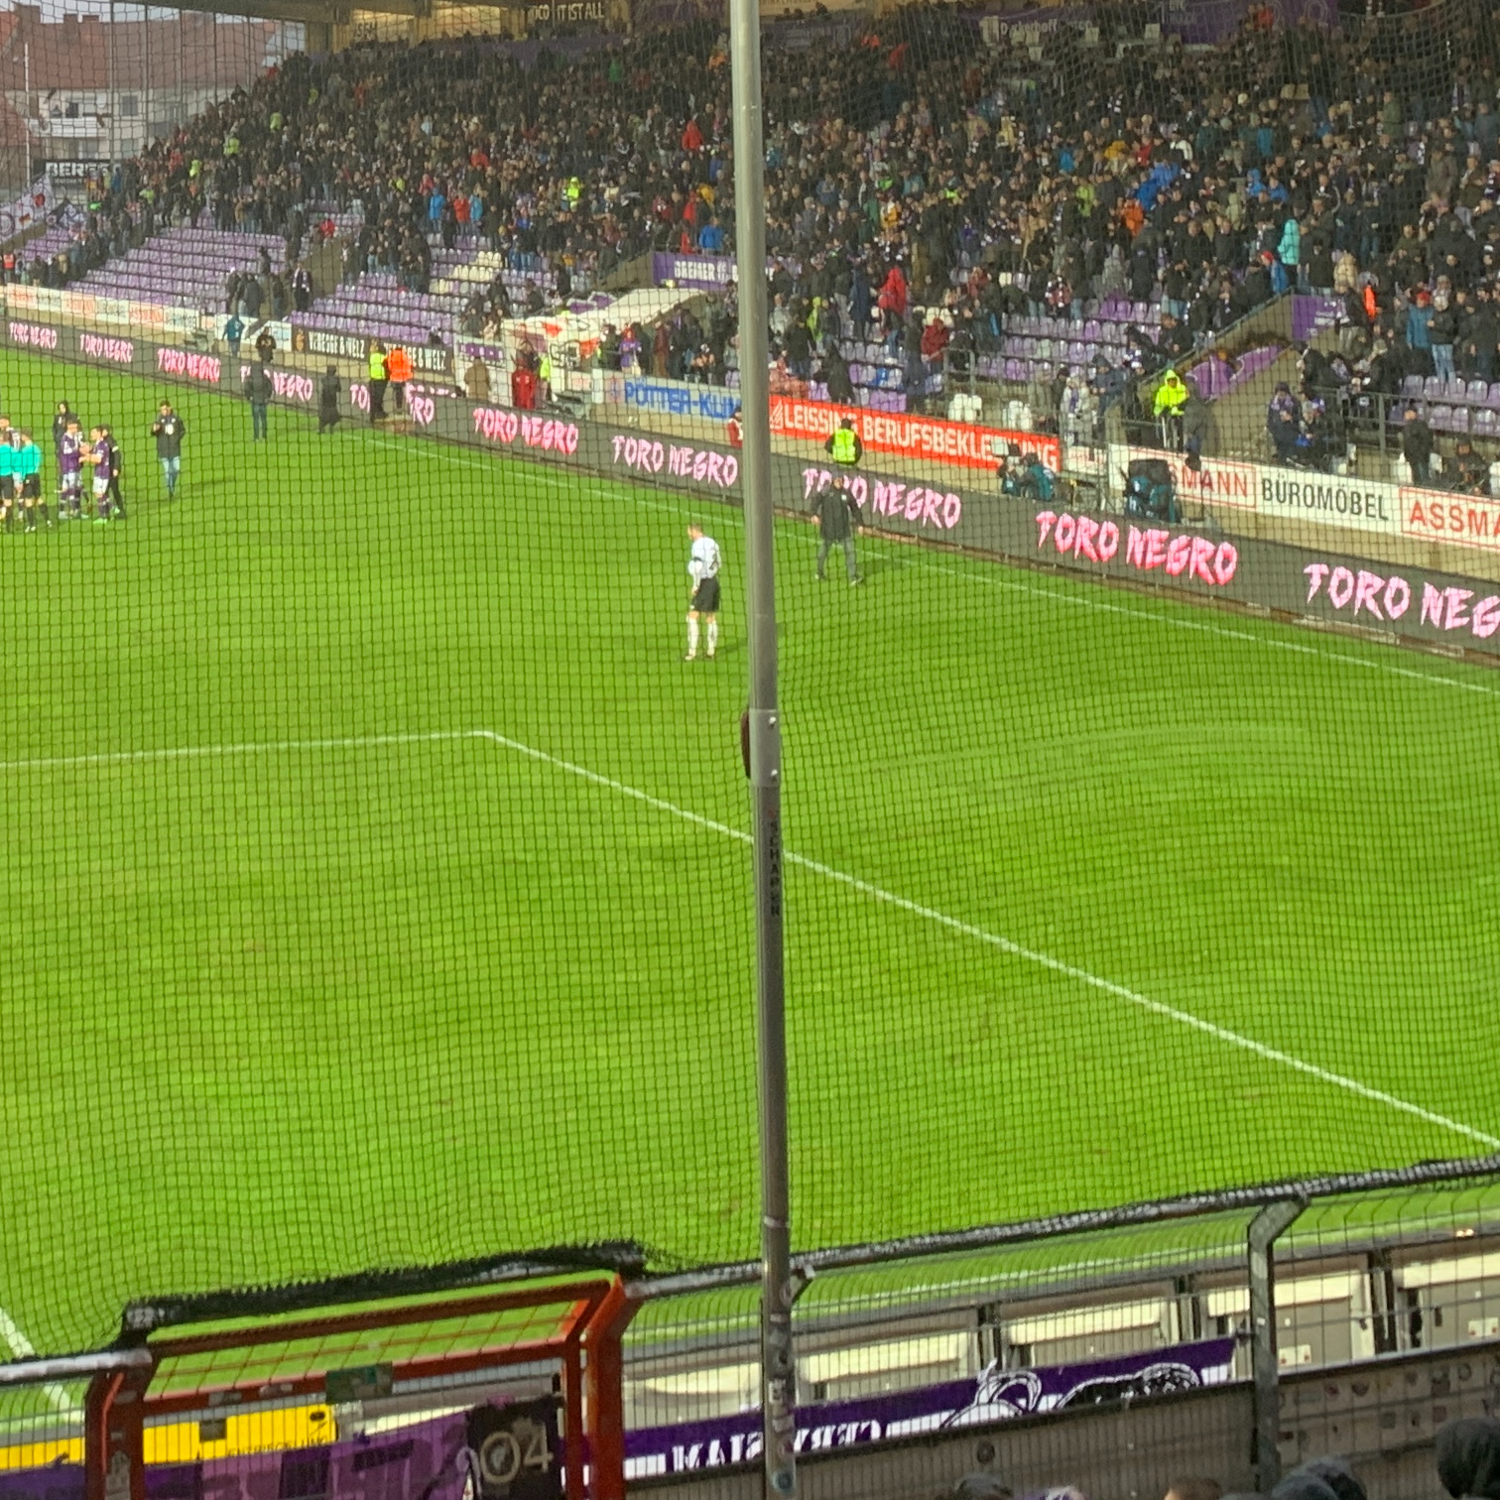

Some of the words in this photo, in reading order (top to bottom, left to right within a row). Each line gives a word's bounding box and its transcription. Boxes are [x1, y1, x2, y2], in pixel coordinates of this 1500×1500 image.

[157, 348, 186, 375] TORO
[186, 352, 221, 383] NEGRO
[273, 371, 314, 401] NEGRO
[473, 407, 518, 443] TORO
[521, 415, 579, 455] NEGRO
[611, 435, 665, 473] TORO
[668, 443, 738, 487] NEGRO
[873, 479, 962, 529] NEGRO
[1261, 474, 1389, 521] BÜROMÖBEL
[1035, 510, 1120, 563] TORO
[1125, 524, 1238, 586] NEGRO
[1303, 562, 1412, 621] TORO
